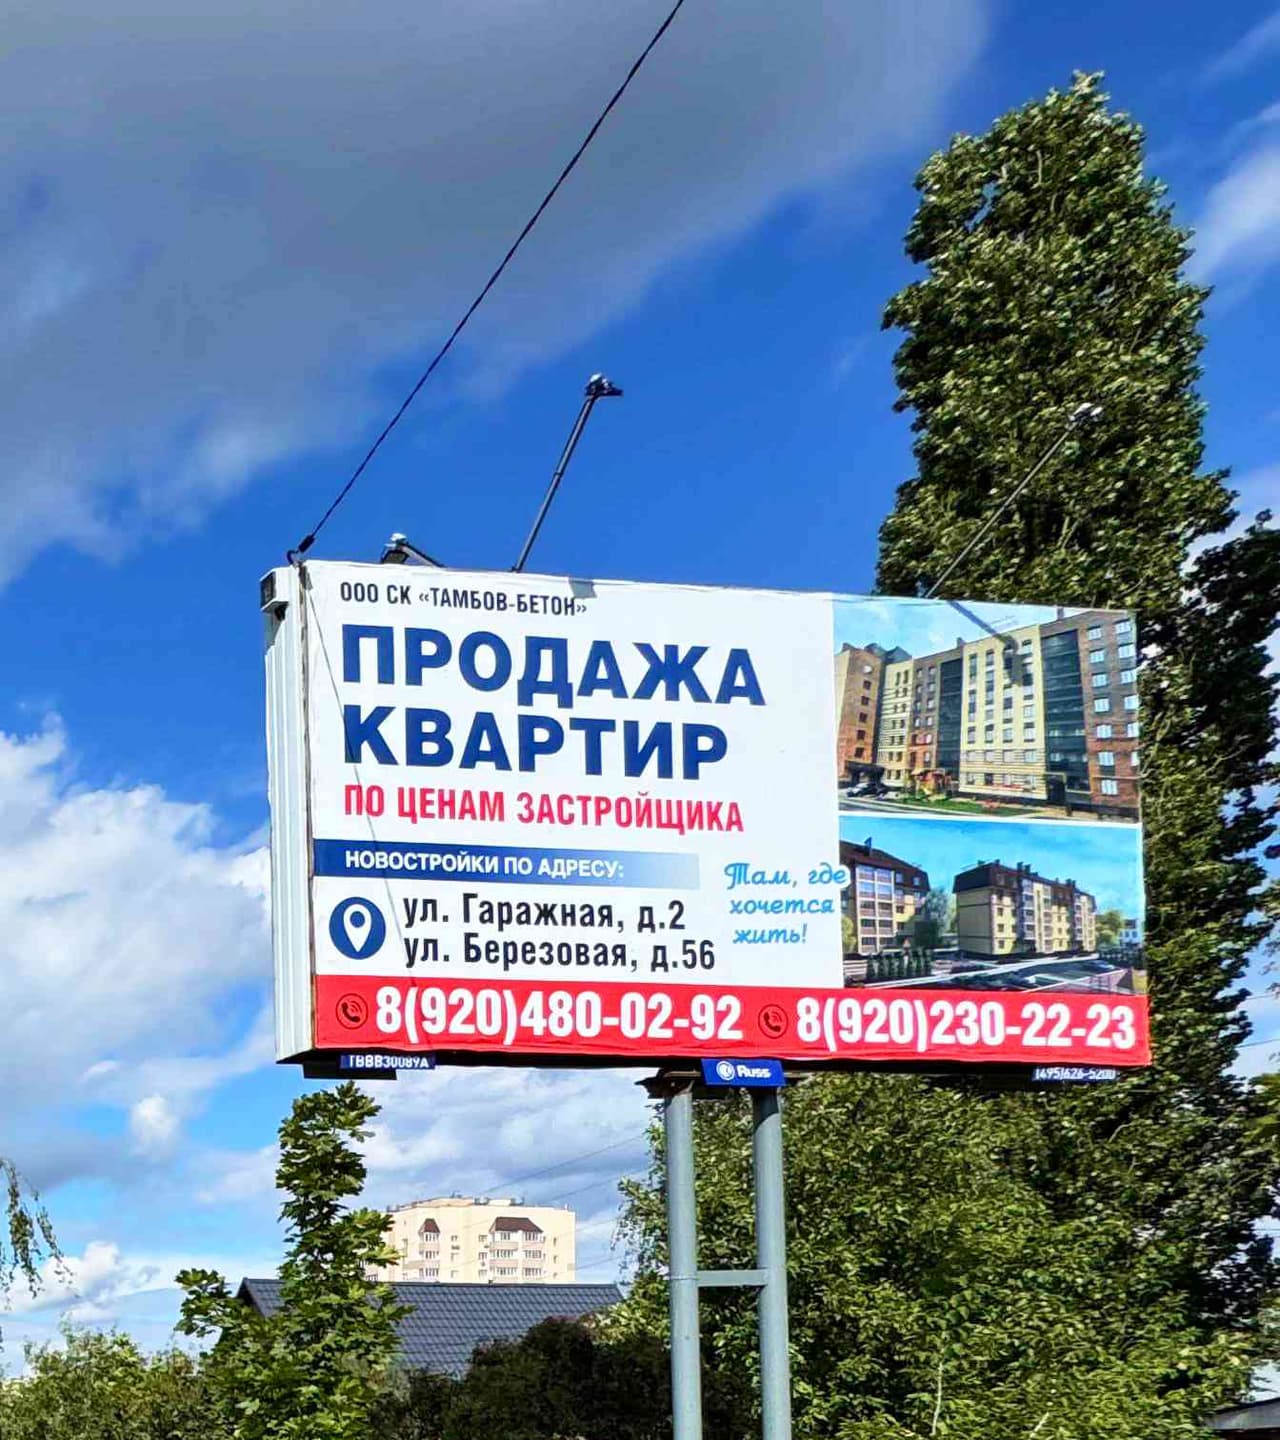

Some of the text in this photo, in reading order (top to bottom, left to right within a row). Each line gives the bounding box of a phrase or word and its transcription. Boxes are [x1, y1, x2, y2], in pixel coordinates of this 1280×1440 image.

[340, 581, 587, 616] ООО СК «ТАМБОВ-БЕТОН»
[342, 624, 766, 709] ПРОДАЖА
[343, 704, 728, 780] КВАРТИР
[344, 784, 744, 836] ПО ЦЕНАМ ЗАСТРОЙЩИКА
[345, 849, 625, 879] НОВОСТРОЙКИ ПО АДРЕСУ:
[724, 862, 848, 890] Там, где
[403, 892, 686, 934] ул. Гаражная, д.2
[729, 898, 835, 915] хочется
[403, 932, 716, 974] ул. Березовая, д.56
[732, 923, 808, 945] жить!
[375, 985, 744, 1046] 8(920)480-02-92
[796, 995, 1138, 1053] 8(920)230-22-23
[736, 1064, 772, 1079] Russ
